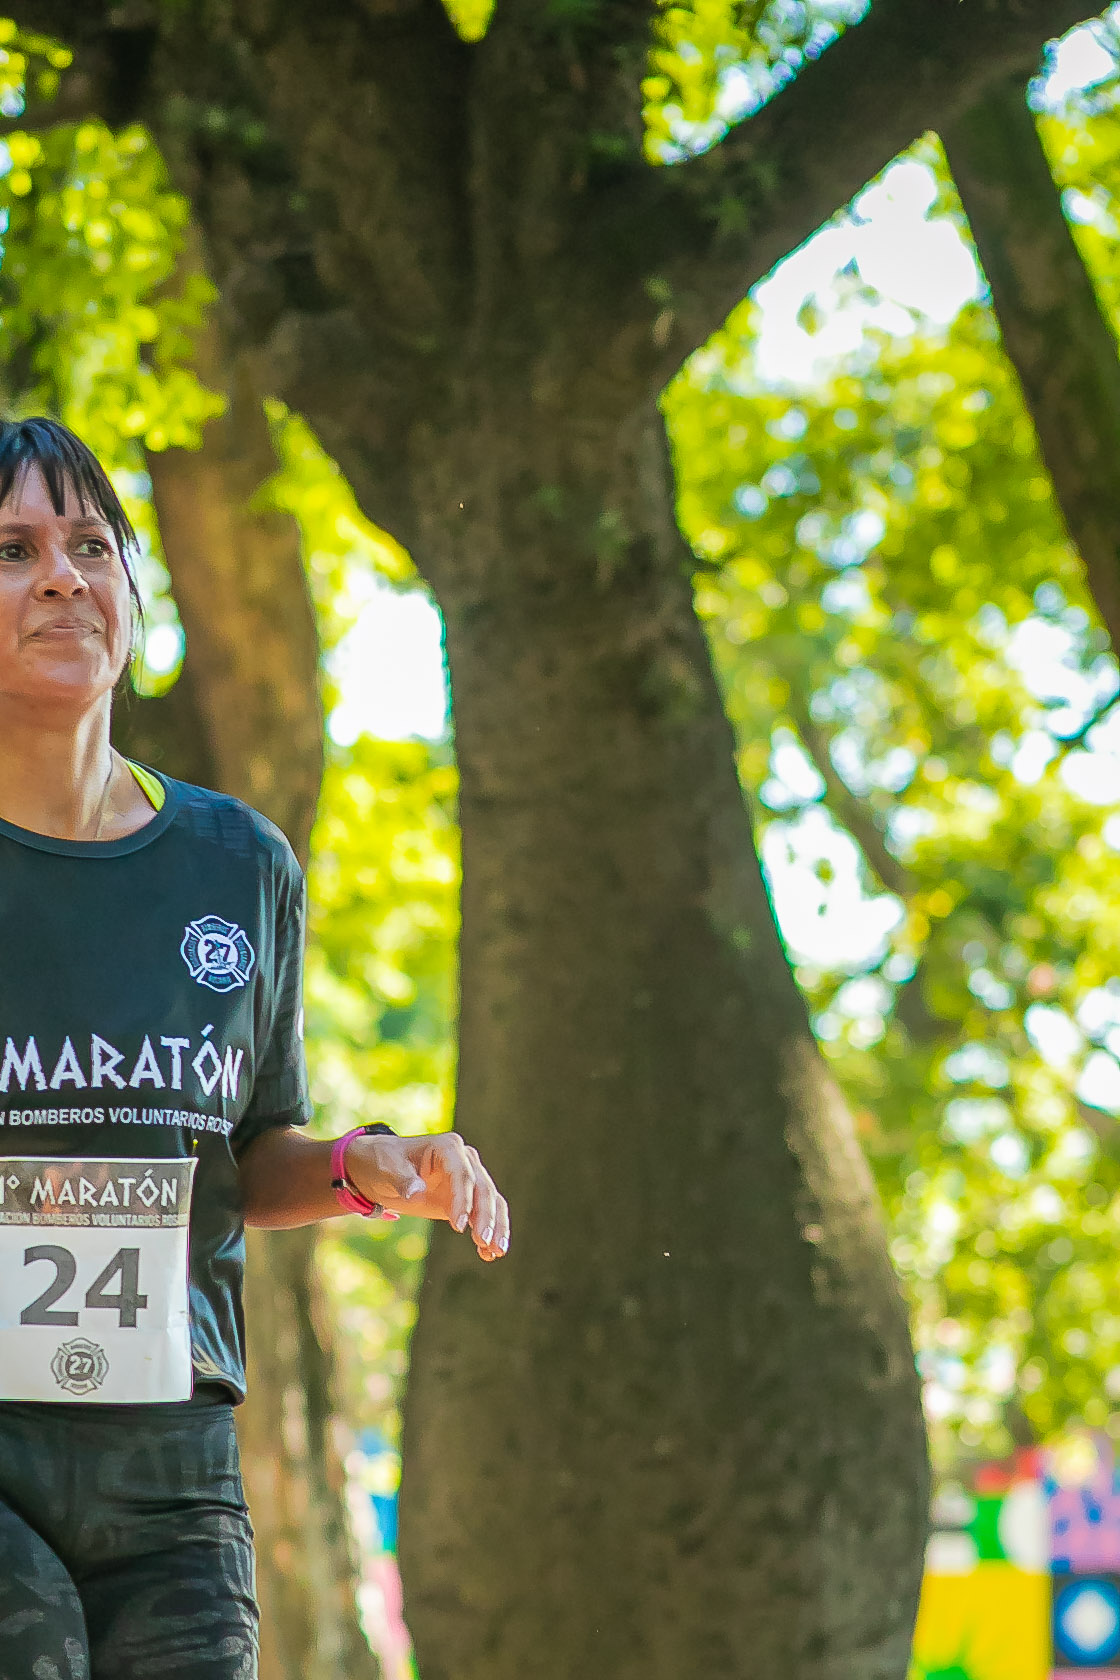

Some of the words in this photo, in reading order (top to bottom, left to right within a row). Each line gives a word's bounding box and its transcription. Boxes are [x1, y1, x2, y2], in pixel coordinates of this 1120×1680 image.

[204, 939, 231, 964] 27
[8, 1107, 105, 1127] BOMBEROS
[108, 1107, 207, 1131] VOLUNTARIOS
[29, 1168, 178, 1208] MARATÓN
[20, 1244, 149, 1328] 24
[68, 1354, 93, 1376] 27
